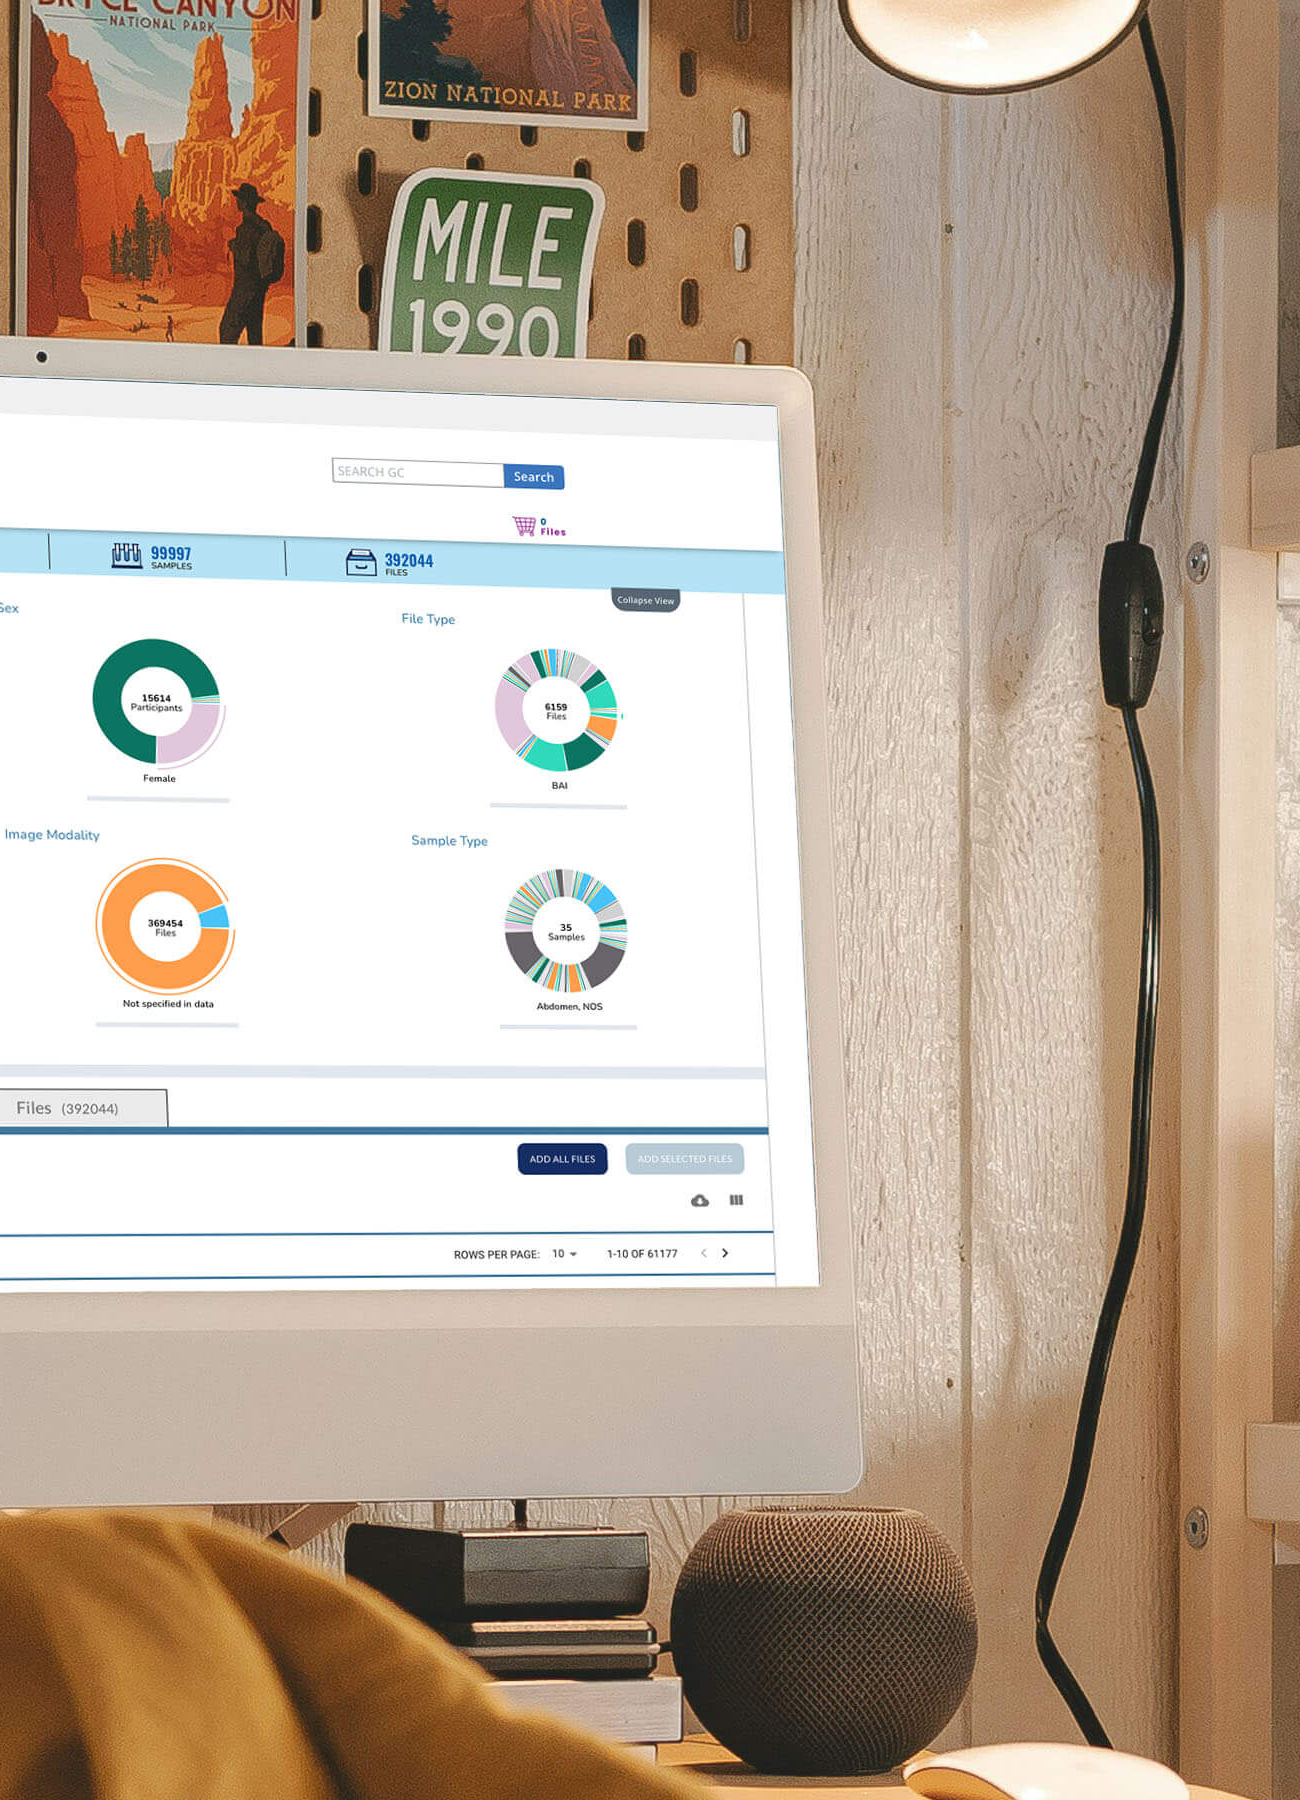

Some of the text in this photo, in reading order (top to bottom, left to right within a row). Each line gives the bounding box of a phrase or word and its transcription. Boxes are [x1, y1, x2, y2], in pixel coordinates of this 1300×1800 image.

[110, 16, 216, 32] NATIONAL PARK
[385, 81, 631, 112] ZION NATIONAL PARK
[412, 198, 573, 290] MILE
[410, 300, 559, 359] 1990
[338, 466, 404, 478] SEARCH GC
[515, 472, 554, 482] Search
[541, 527, 566, 536] Files
[151, 546, 191, 560] 99997
[385, 553, 433, 567] 392044
[151, 562, 192, 570] SAMPLES
[386, 568, 408, 576] FILES
[617, 596, 674, 605] Collapse View
[402, 613, 455, 627] File Type
[143, 694, 171, 702] 15614
[131, 703, 182, 715] Participants
[545, 703, 567, 712] 6159
[547, 712, 566, 720] Files
[144, 774, 176, 782] Female
[5, 829, 100, 842] Image Modality
[412, 835, 488, 848] Sample Type
[148, 919, 183, 927] 369454
[156, 928, 176, 937] Files
[548, 933, 585, 942] Samples
[142, 1000, 181, 1008] specified
[184, 1000, 191, 1008] in
[195, 1000, 214, 1008] data
[537, 1002, 580, 1011] Abdomen,
[17, 1101, 118, 1116] Files (392044)
[530, 1155, 595, 1163] ADD ALL FILES
[638, 1154, 733, 1164] ADD SELECTED FILES
[454, 1250, 540, 1259] ROWS PER PAGE:
[553, 1249, 564, 1258] 10
[608, 1249, 677, 1258] 1-10 OF 61177
